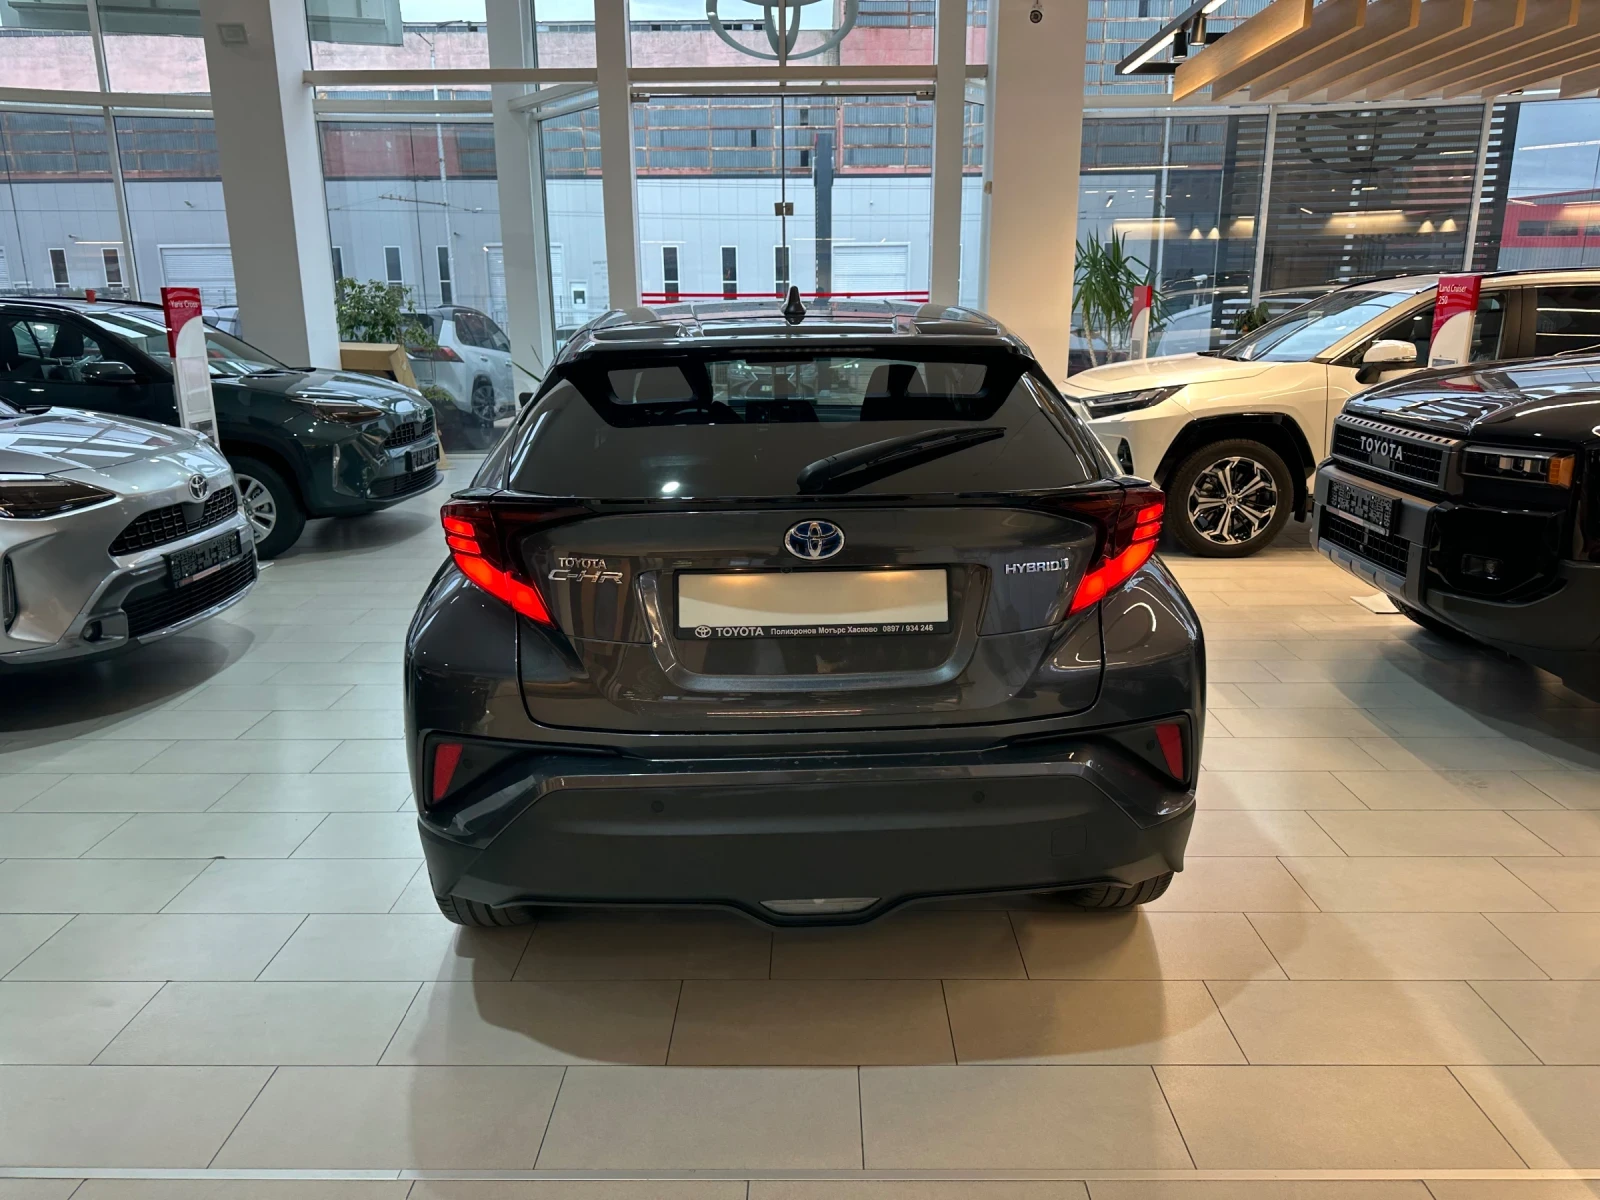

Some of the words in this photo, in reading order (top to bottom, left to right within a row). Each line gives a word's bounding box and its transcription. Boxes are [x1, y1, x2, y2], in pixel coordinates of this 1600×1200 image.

[1439, 284, 1450, 293] Land
[1451, 284, 1467, 293] Cruiser
[170, 300, 183, 308] Yaris
[184, 300, 198, 308] Cross
[1438, 296, 1449, 305] 250
[1360, 435, 1403, 461] TOYOTA
[558, 557, 607, 570] TOYOTA
[548, 569, 623, 584] C-HR
[716, 626, 765, 637] TOYOTA
[771, 627, 817, 636] Полихронов
[818, 626, 846, 635] Мотърс
[847, 625, 878, 634] Хасково
[882, 625, 900, 633] 0897
[906, 624, 919, 632] 934
